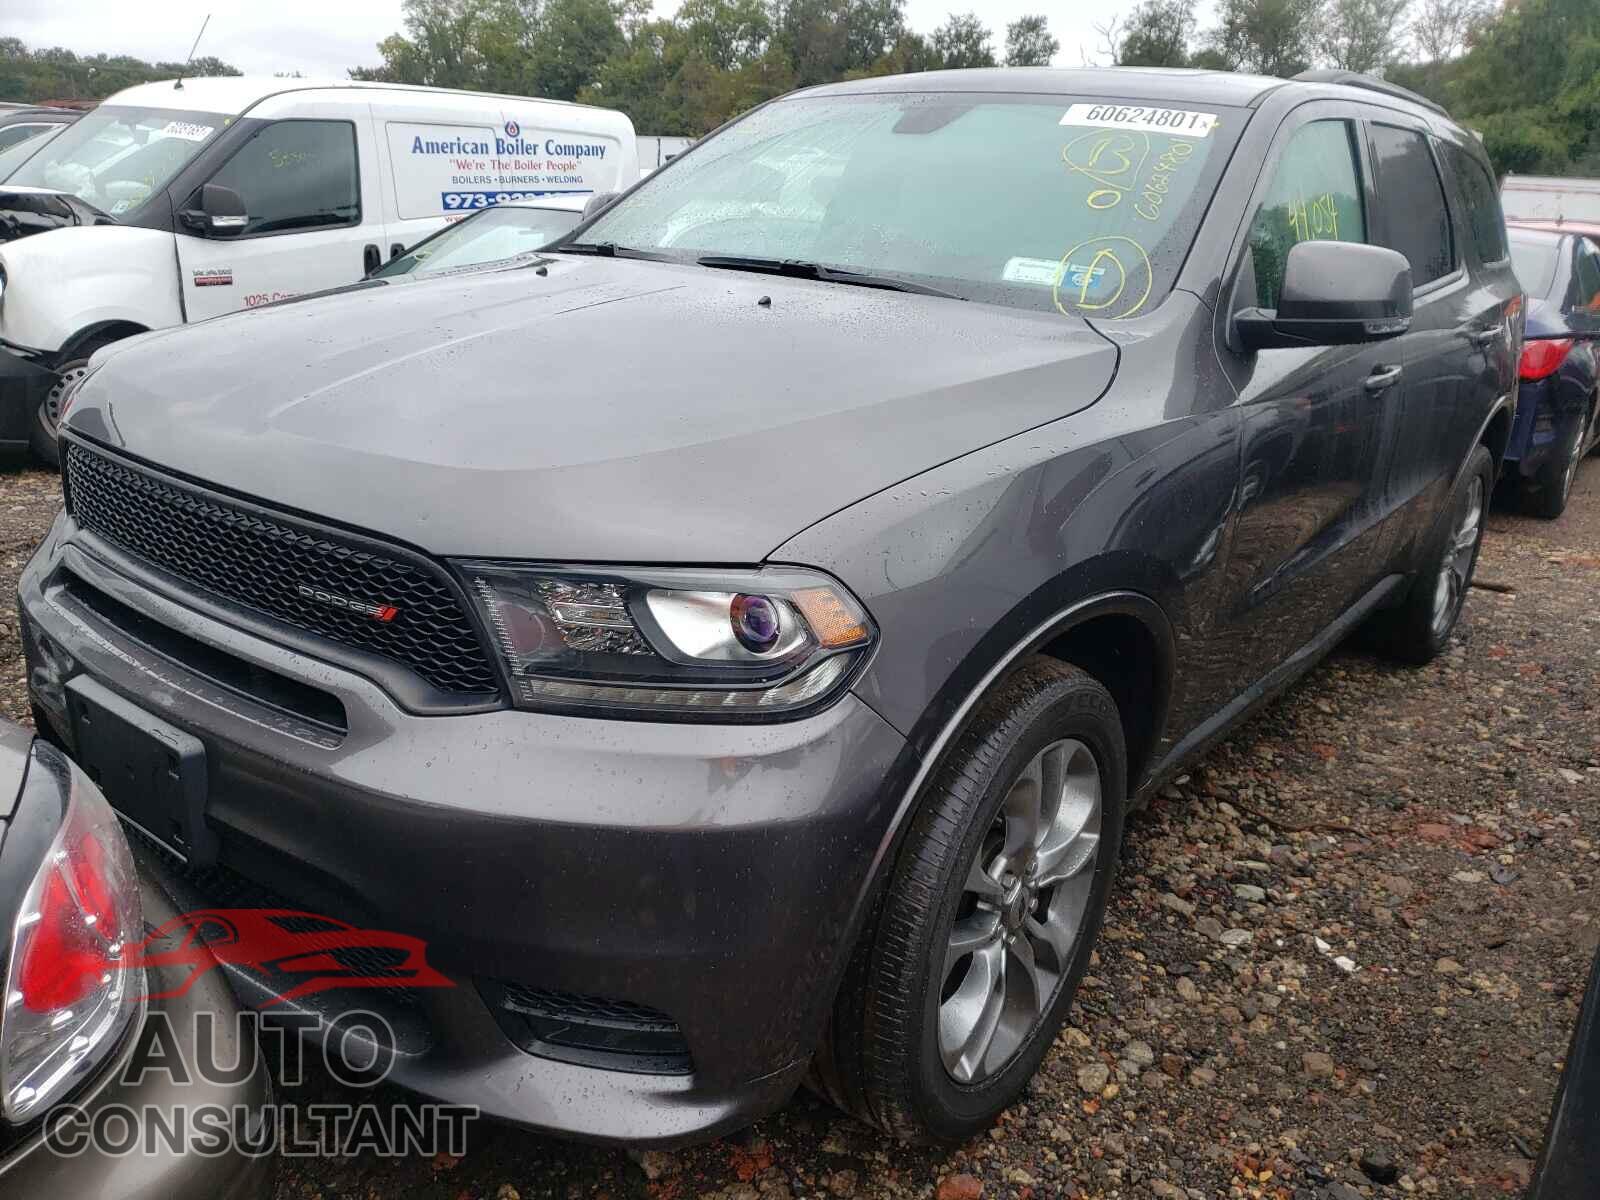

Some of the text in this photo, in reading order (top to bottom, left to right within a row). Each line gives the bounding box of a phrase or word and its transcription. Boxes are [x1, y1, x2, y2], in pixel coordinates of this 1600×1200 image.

[1086, 105, 1200, 128] 60624801
[412, 136, 606, 159] American Boiler Company
[450, 159, 582, 172] "We're The Boiler People"
[452, 175, 583, 185] BOILERS BURNERS WELDING
[244, 294, 269, 307] 1025
[298, 585, 384, 617] DODGE
